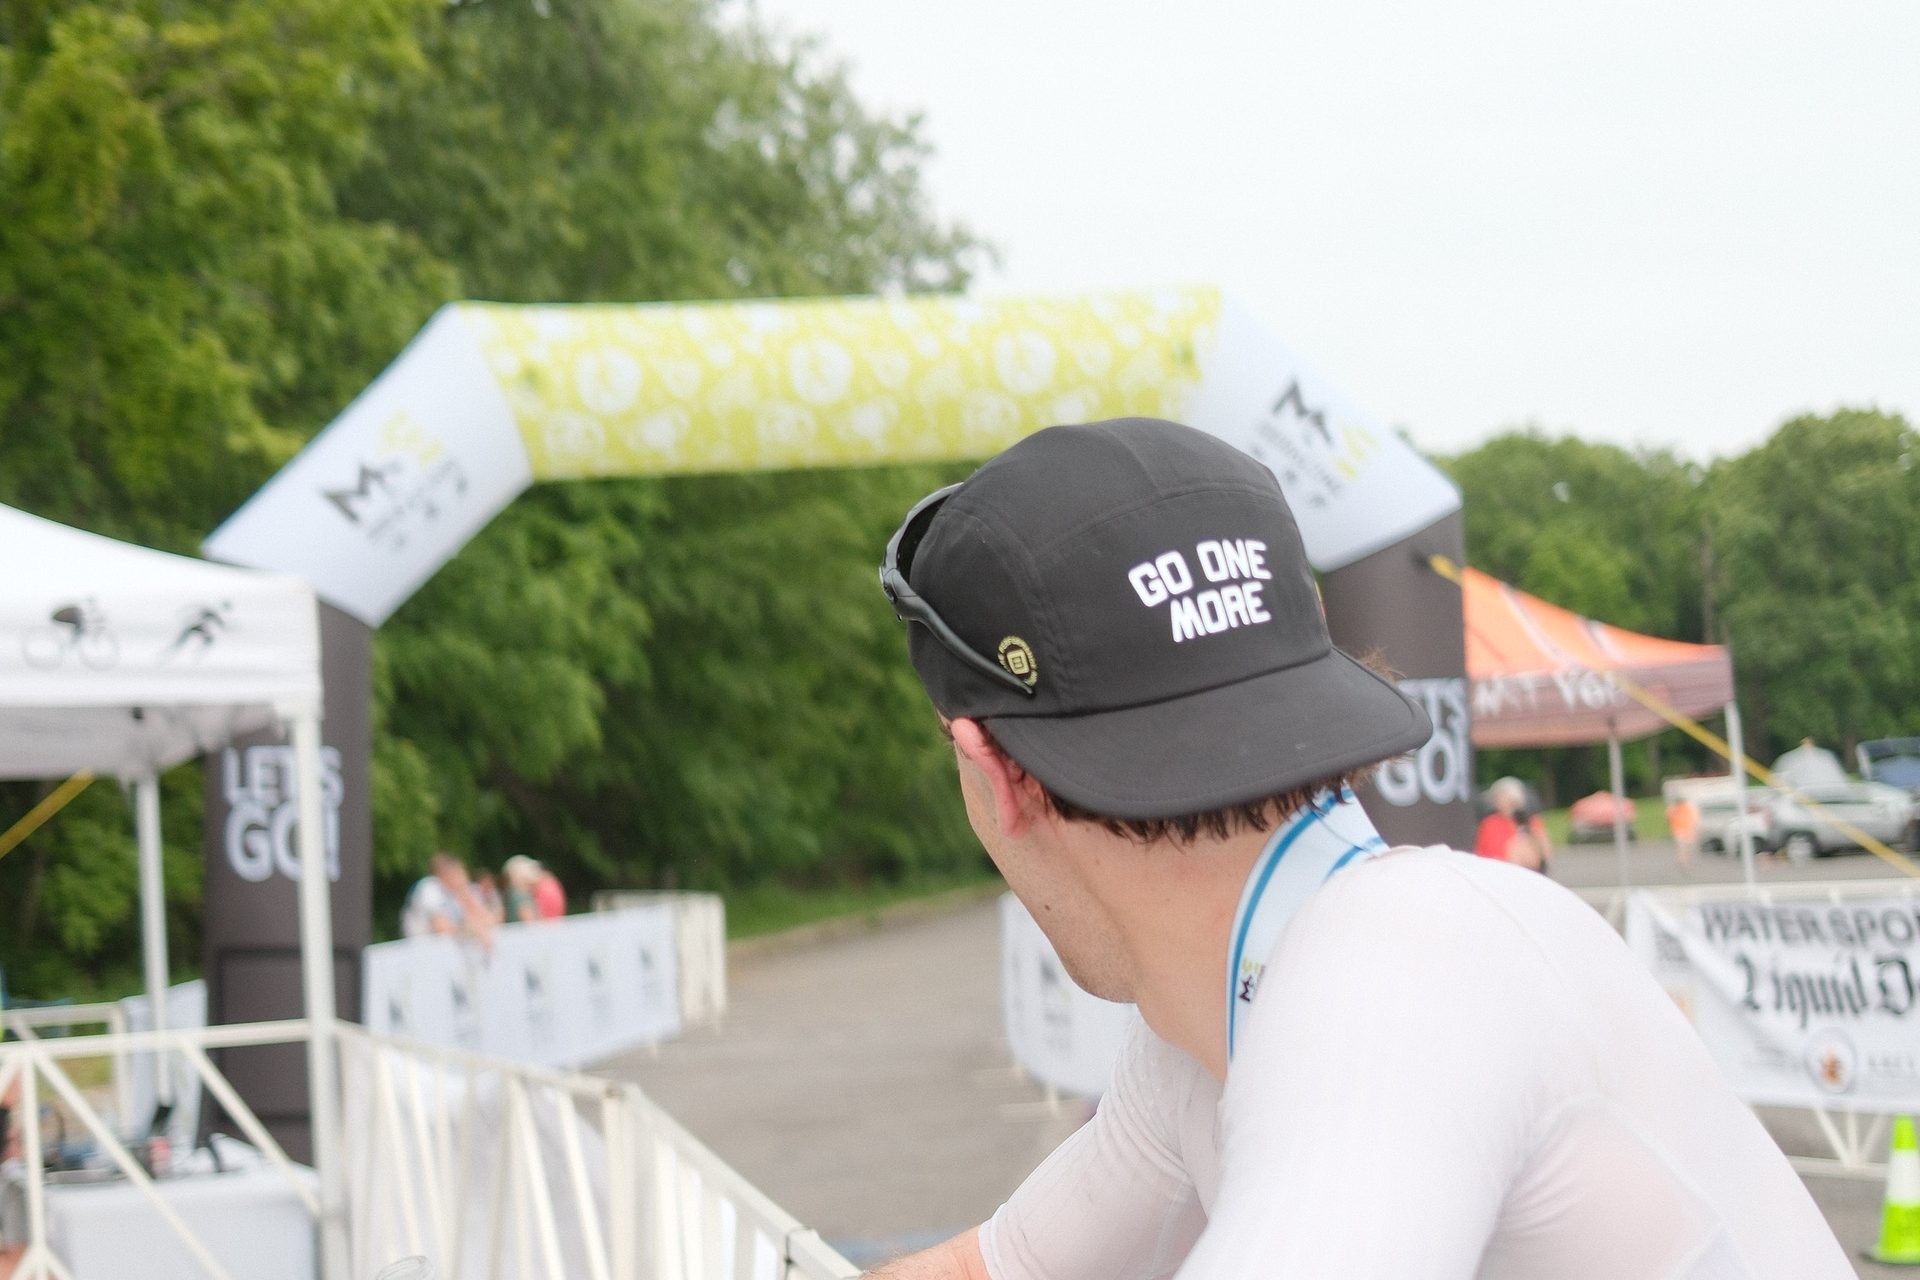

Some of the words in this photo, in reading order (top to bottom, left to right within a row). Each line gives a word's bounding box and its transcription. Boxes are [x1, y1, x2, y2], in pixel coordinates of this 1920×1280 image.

[1128, 550, 1194, 607] GO
[1196, 538, 1272, 583] ONE
[1170, 581, 1272, 643] MORE
[1827, 906, 1920, 948] SPO
